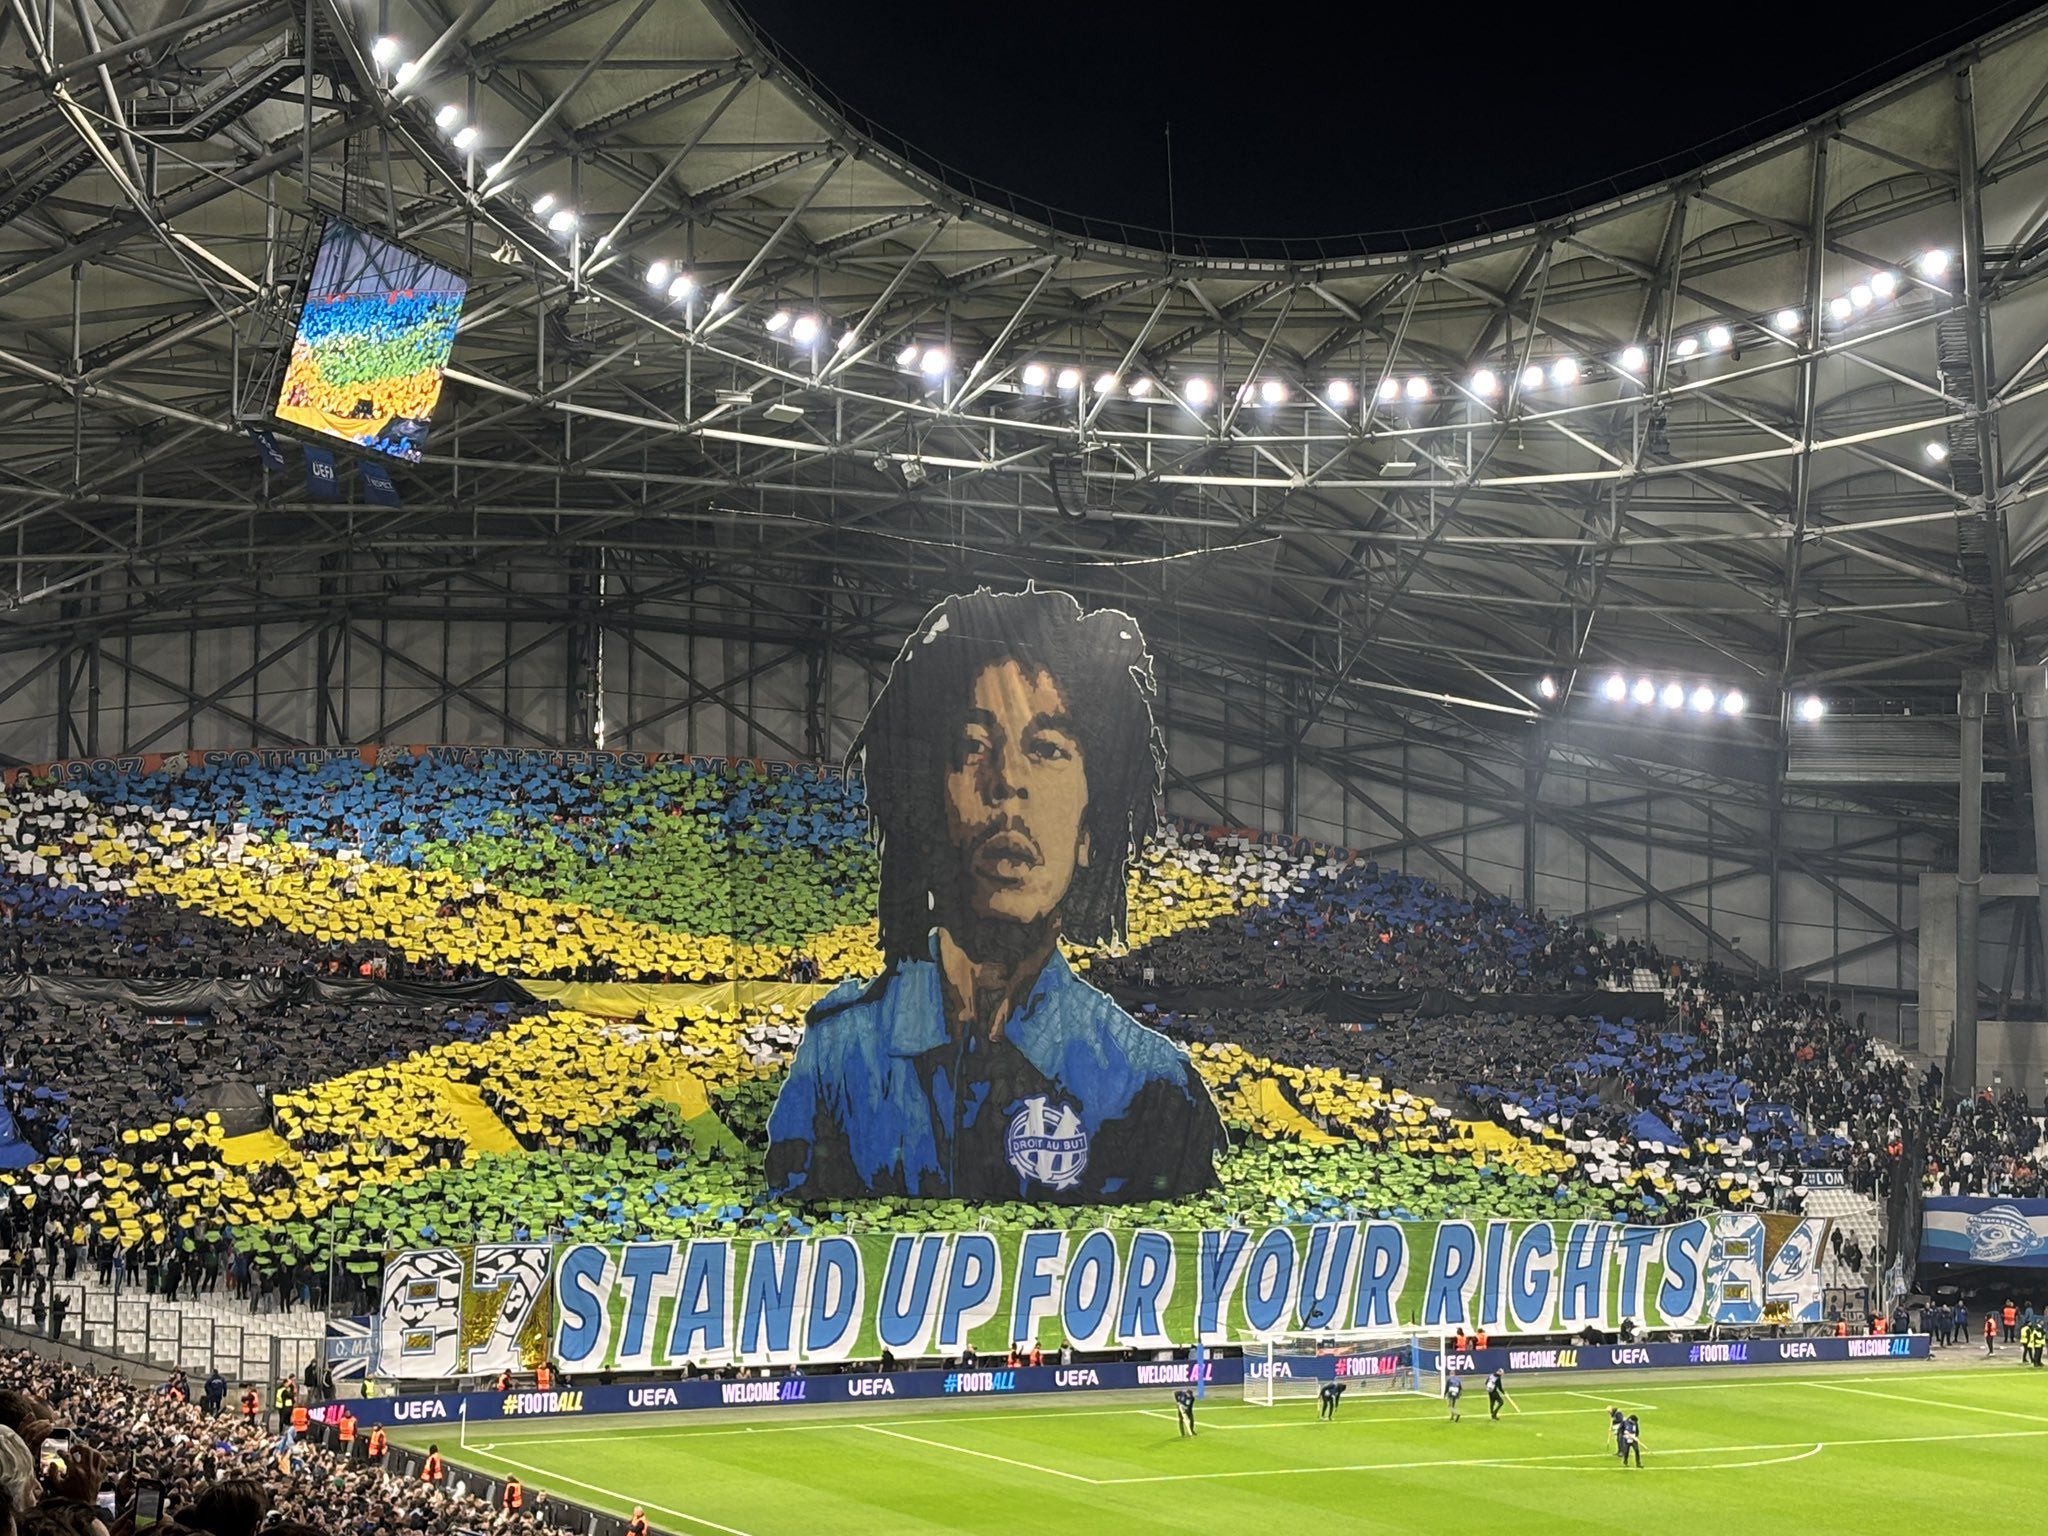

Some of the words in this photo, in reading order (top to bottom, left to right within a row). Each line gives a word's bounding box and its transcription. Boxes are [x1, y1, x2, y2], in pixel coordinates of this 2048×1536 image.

[312, 461, 334, 480] UEFA
[48, 756, 145, 783] 1987
[1012, 1138, 1043, 1151] DROIT
[1046, 1141, 1060, 1151] AU
[1063, 1138, 1084, 1150] BUT
[1706, 1212, 1827, 1323] 84
[556, 1236, 862, 1365] STAND
[877, 1233, 999, 1356] UP
[1010, 1229, 1175, 1346] FOR
[1196, 1221, 1407, 1337] YOUR
[1421, 1217, 1711, 1329] RIGHTS
[378, 1246, 552, 1377] 87
[1611, 1348, 1650, 1364] UEFA
[1689, 1343, 1748, 1363] #FOOTBALL
[1780, 1342, 1817, 1358] UEFA
[1848, 1339, 1891, 1358] WELCOME
[1890, 1337, 1911, 1356] ALL
[1250, 1361, 1292, 1378] UEFA
[1334, 1355, 1399, 1377] #FOOTBALL
[1434, 1354, 1476, 1371] UEFA
[1510, 1351, 1557, 1370] WELCOME
[1556, 1349, 1578, 1368] ALL
[943, 1371, 1016, 1393] #FOOTBALL
[1055, 1369, 1100, 1387] UEFA
[1137, 1364, 1190, 1384] WELCOME
[722, 1381, 781, 1404] WELCOME
[780, 1379, 807, 1400] ALL
[848, 1378, 895, 1396] UEFA
[502, 1391, 583, 1415] #FOOTBALL
[628, 1388, 678, 1408] UEFA
[394, 1400, 447, 1420] UEFA
